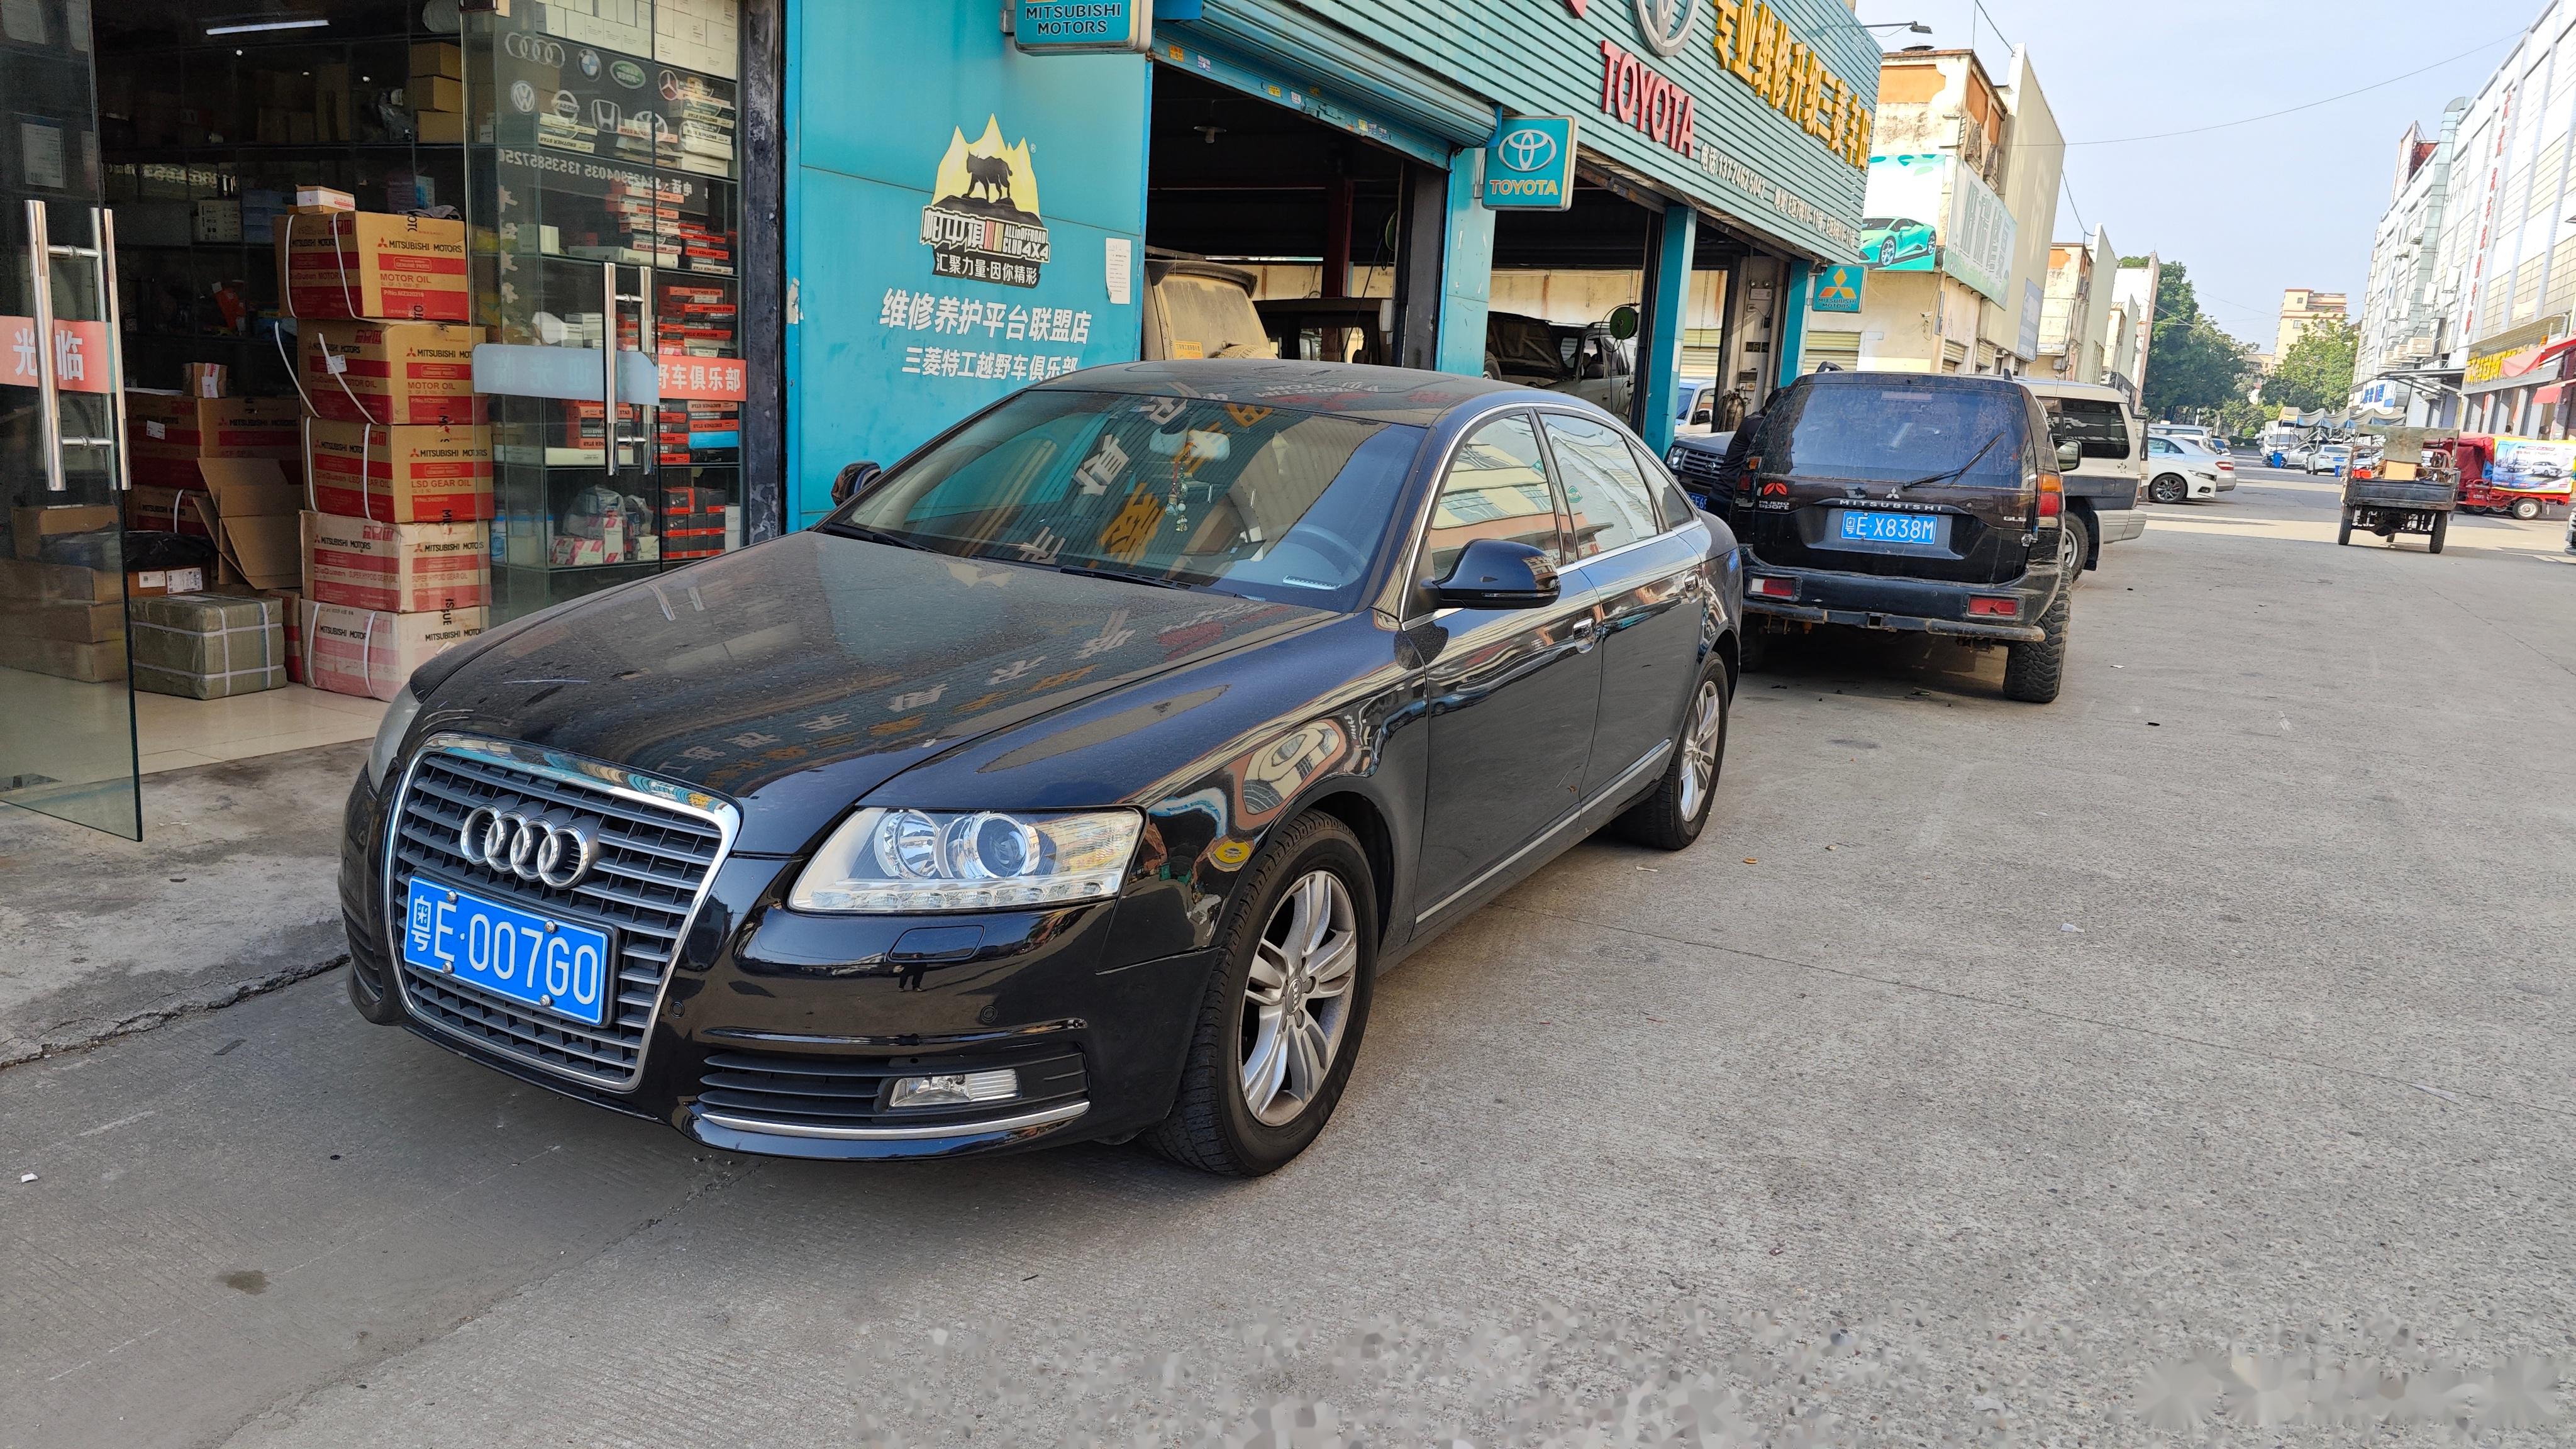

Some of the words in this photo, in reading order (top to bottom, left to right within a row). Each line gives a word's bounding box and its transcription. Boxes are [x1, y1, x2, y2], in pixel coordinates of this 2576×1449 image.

[1026, 3, 1122, 20] MITSUBISHI
[1038, 20, 1108, 35] MOTORS
[1601, 40, 1695, 158] TOYOTA
[1489, 179, 1558, 195] TOYOTA
[389, 240, 430, 250] MITSUBISHI
[433, 244, 462, 253] MOTORS
[1002, 236, 1021, 255] CLUB
[1022, 242, 1049, 259] 4X4
[380, 274, 414, 282] MOTOR
[416, 275, 432, 284] OIL
[879, 287, 1092, 345] 维修养护平台联盟店
[418, 349, 456, 358] MITSUBISHI
[901, 346, 1079, 382] 三菱特工越野车俱乐部
[408, 382, 440, 390] MOTOR
[442, 382, 456, 391] OIL
[321, 441, 347, 452] MITSUBISHI
[431, 479, 455, 487] GEAR
[1839, 499, 1942, 511] MITSUBISHI
[321, 536, 348, 547] MITSUBISHI
[350, 540, 372, 550] MOTORS
[424, 543, 460, 552] MITSUBISHI
[320, 625, 347, 636] MITSUBISHI
[425, 630, 461, 642] MITSUBISHI
